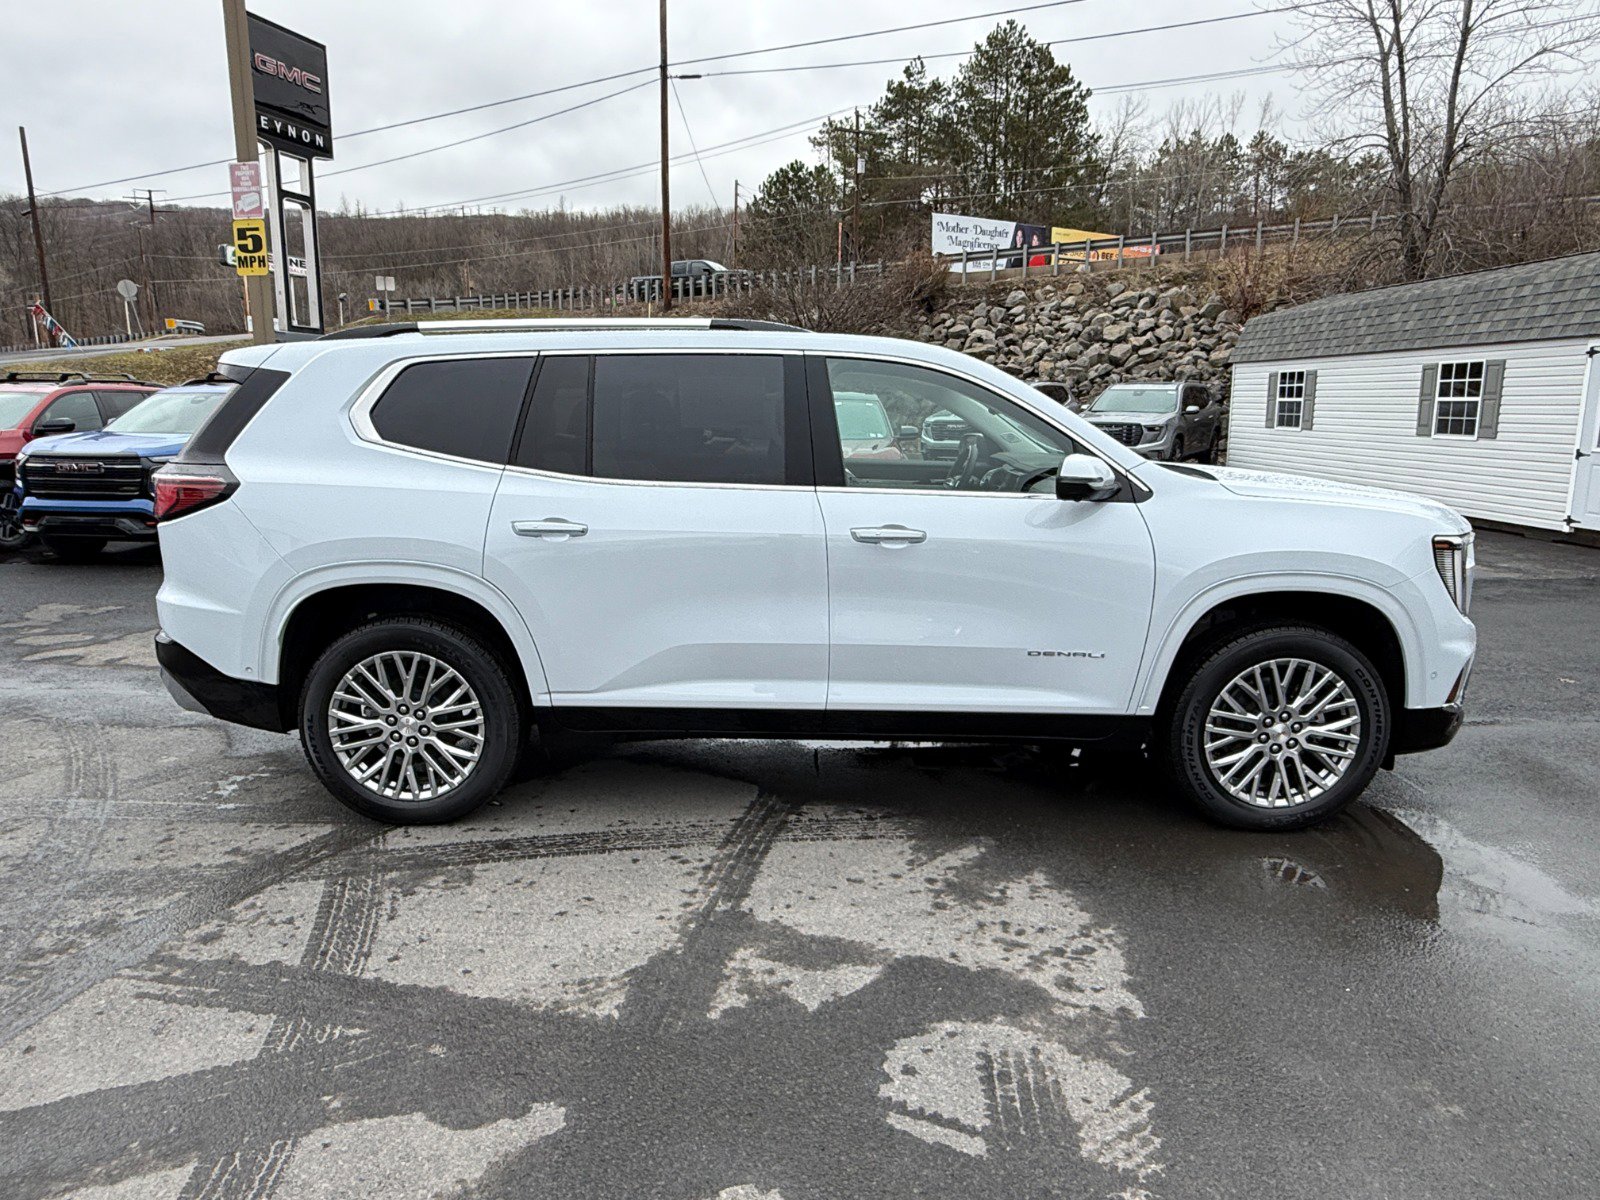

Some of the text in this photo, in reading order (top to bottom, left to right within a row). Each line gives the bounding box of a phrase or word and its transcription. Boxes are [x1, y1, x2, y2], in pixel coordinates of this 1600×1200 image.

[255, 52, 321, 94] GMC
[260, 115, 324, 147] EYNON
[237, 227, 263, 254] 5
[237, 255, 266, 269] MPH
[1027, 650, 1105, 659] DENALI
[1184, 700, 1215, 800] CONTINENTA
